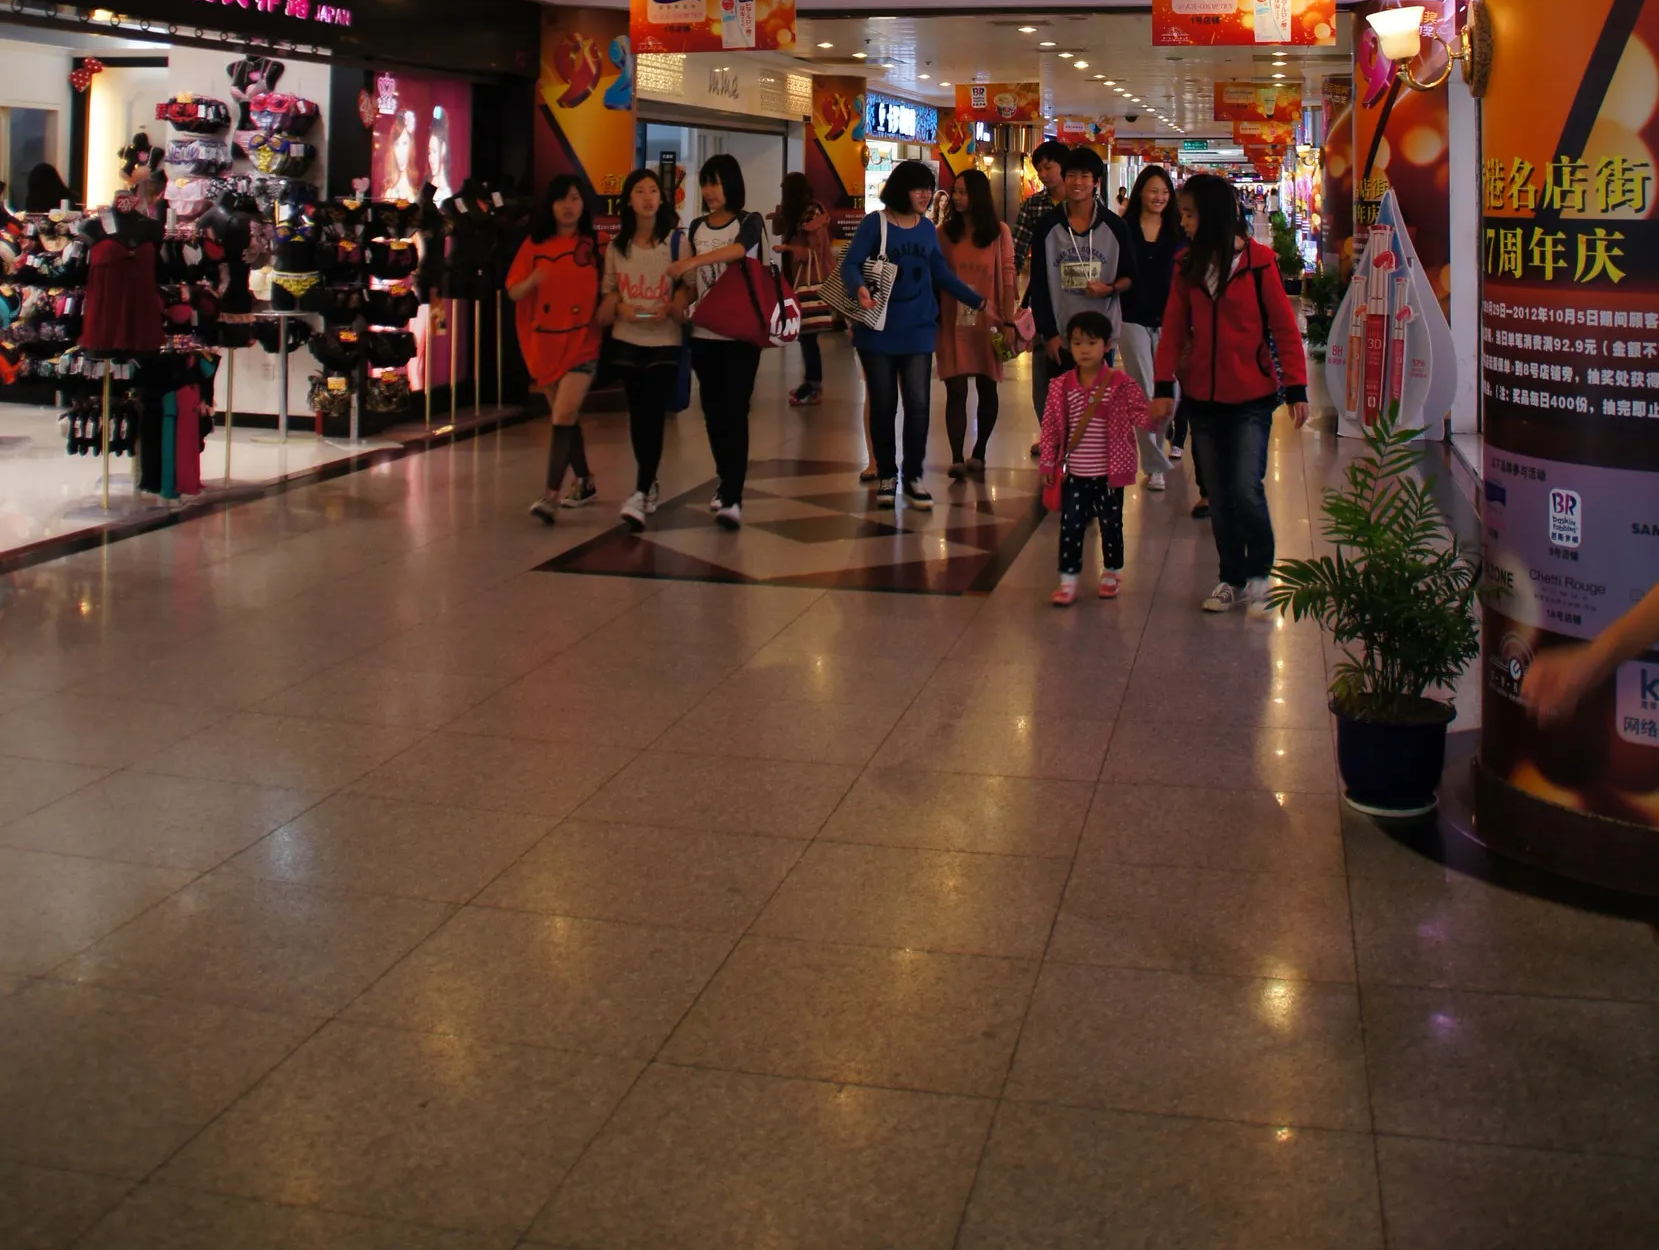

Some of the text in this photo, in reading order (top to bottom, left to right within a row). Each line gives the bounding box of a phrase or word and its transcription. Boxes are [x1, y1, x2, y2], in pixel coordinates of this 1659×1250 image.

[313, 4, 354, 27] JAPAN
[1552, 492, 1577, 516] BR
[1565, 575, 1606, 595] Rouge
